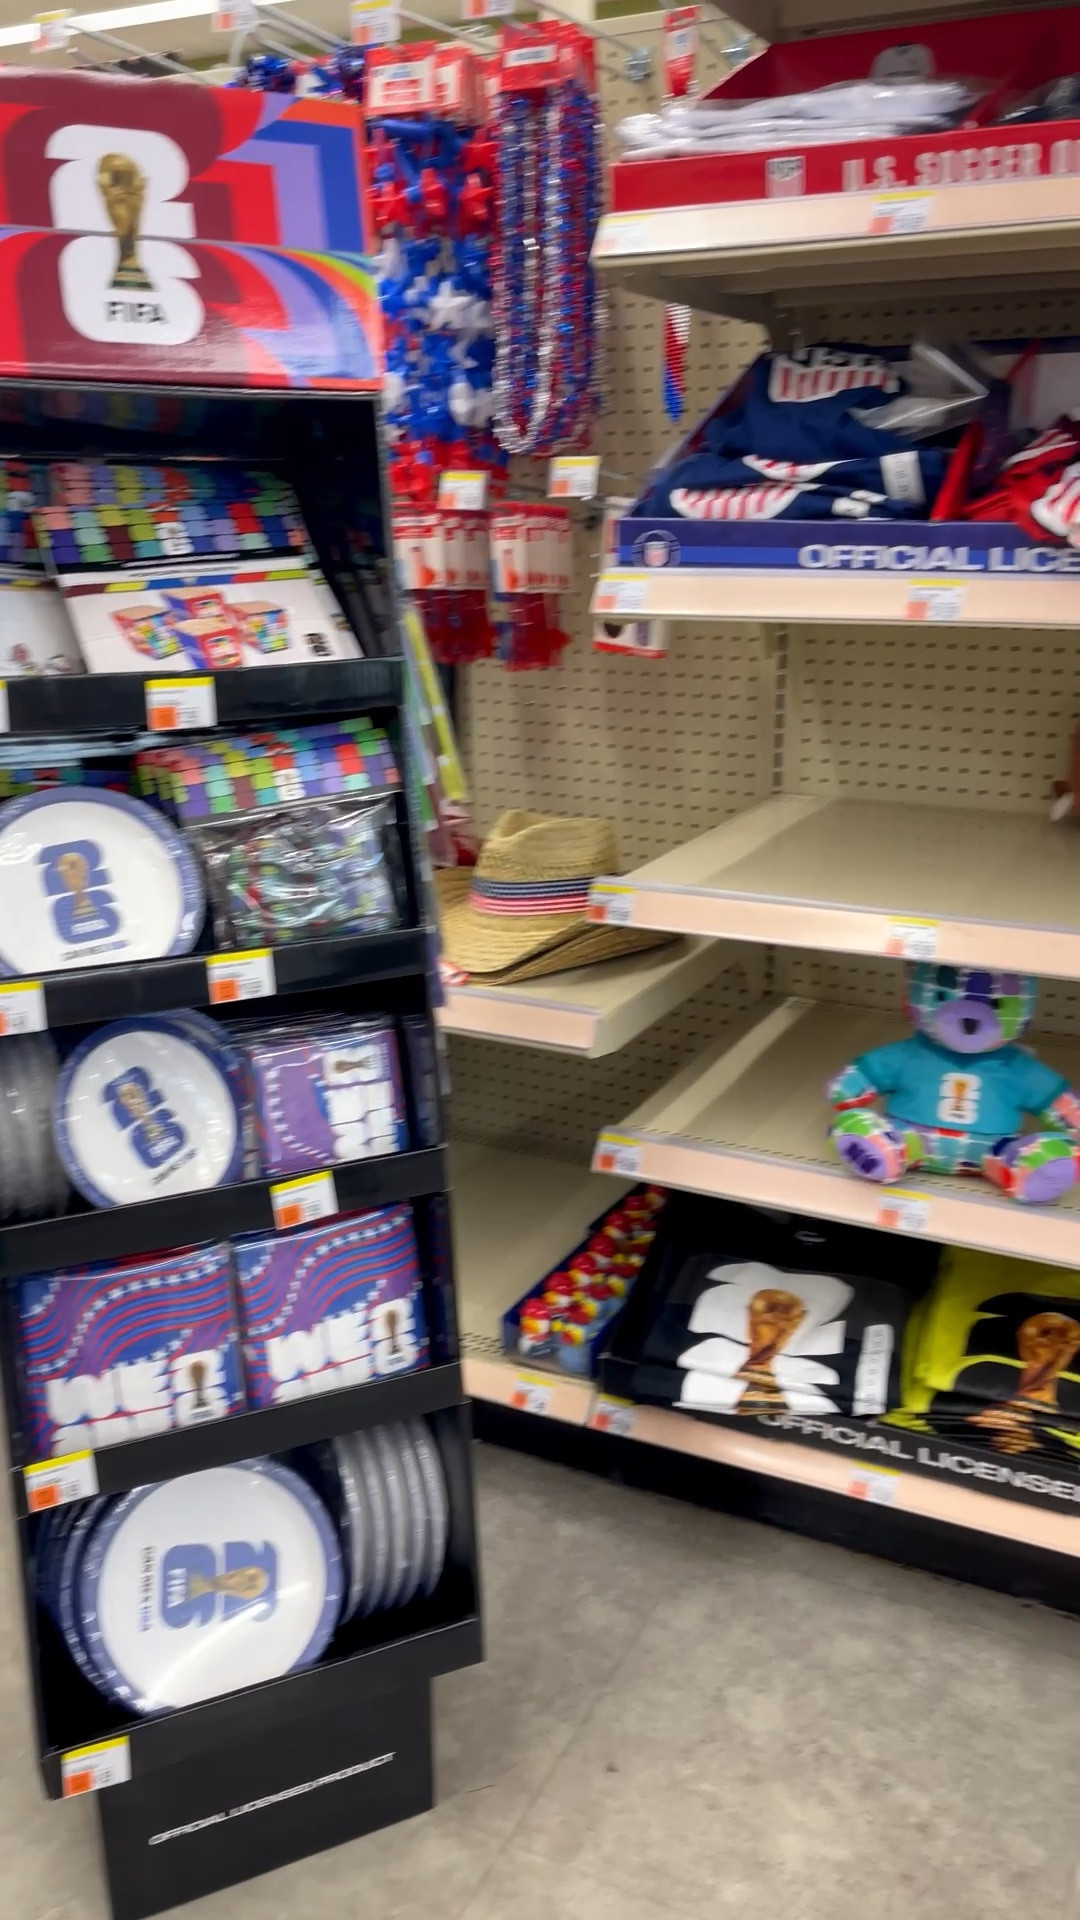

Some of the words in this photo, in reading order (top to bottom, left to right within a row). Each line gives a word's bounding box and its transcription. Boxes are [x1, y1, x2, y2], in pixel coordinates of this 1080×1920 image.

[842, 155, 907, 192] U.S.
[914, 142, 1041, 186] SOCCER
[105, 300, 168, 325] FIFA
[798, 544, 984, 571] OFFICIAL
[756, 1413, 914, 1459] OFFICIAL
